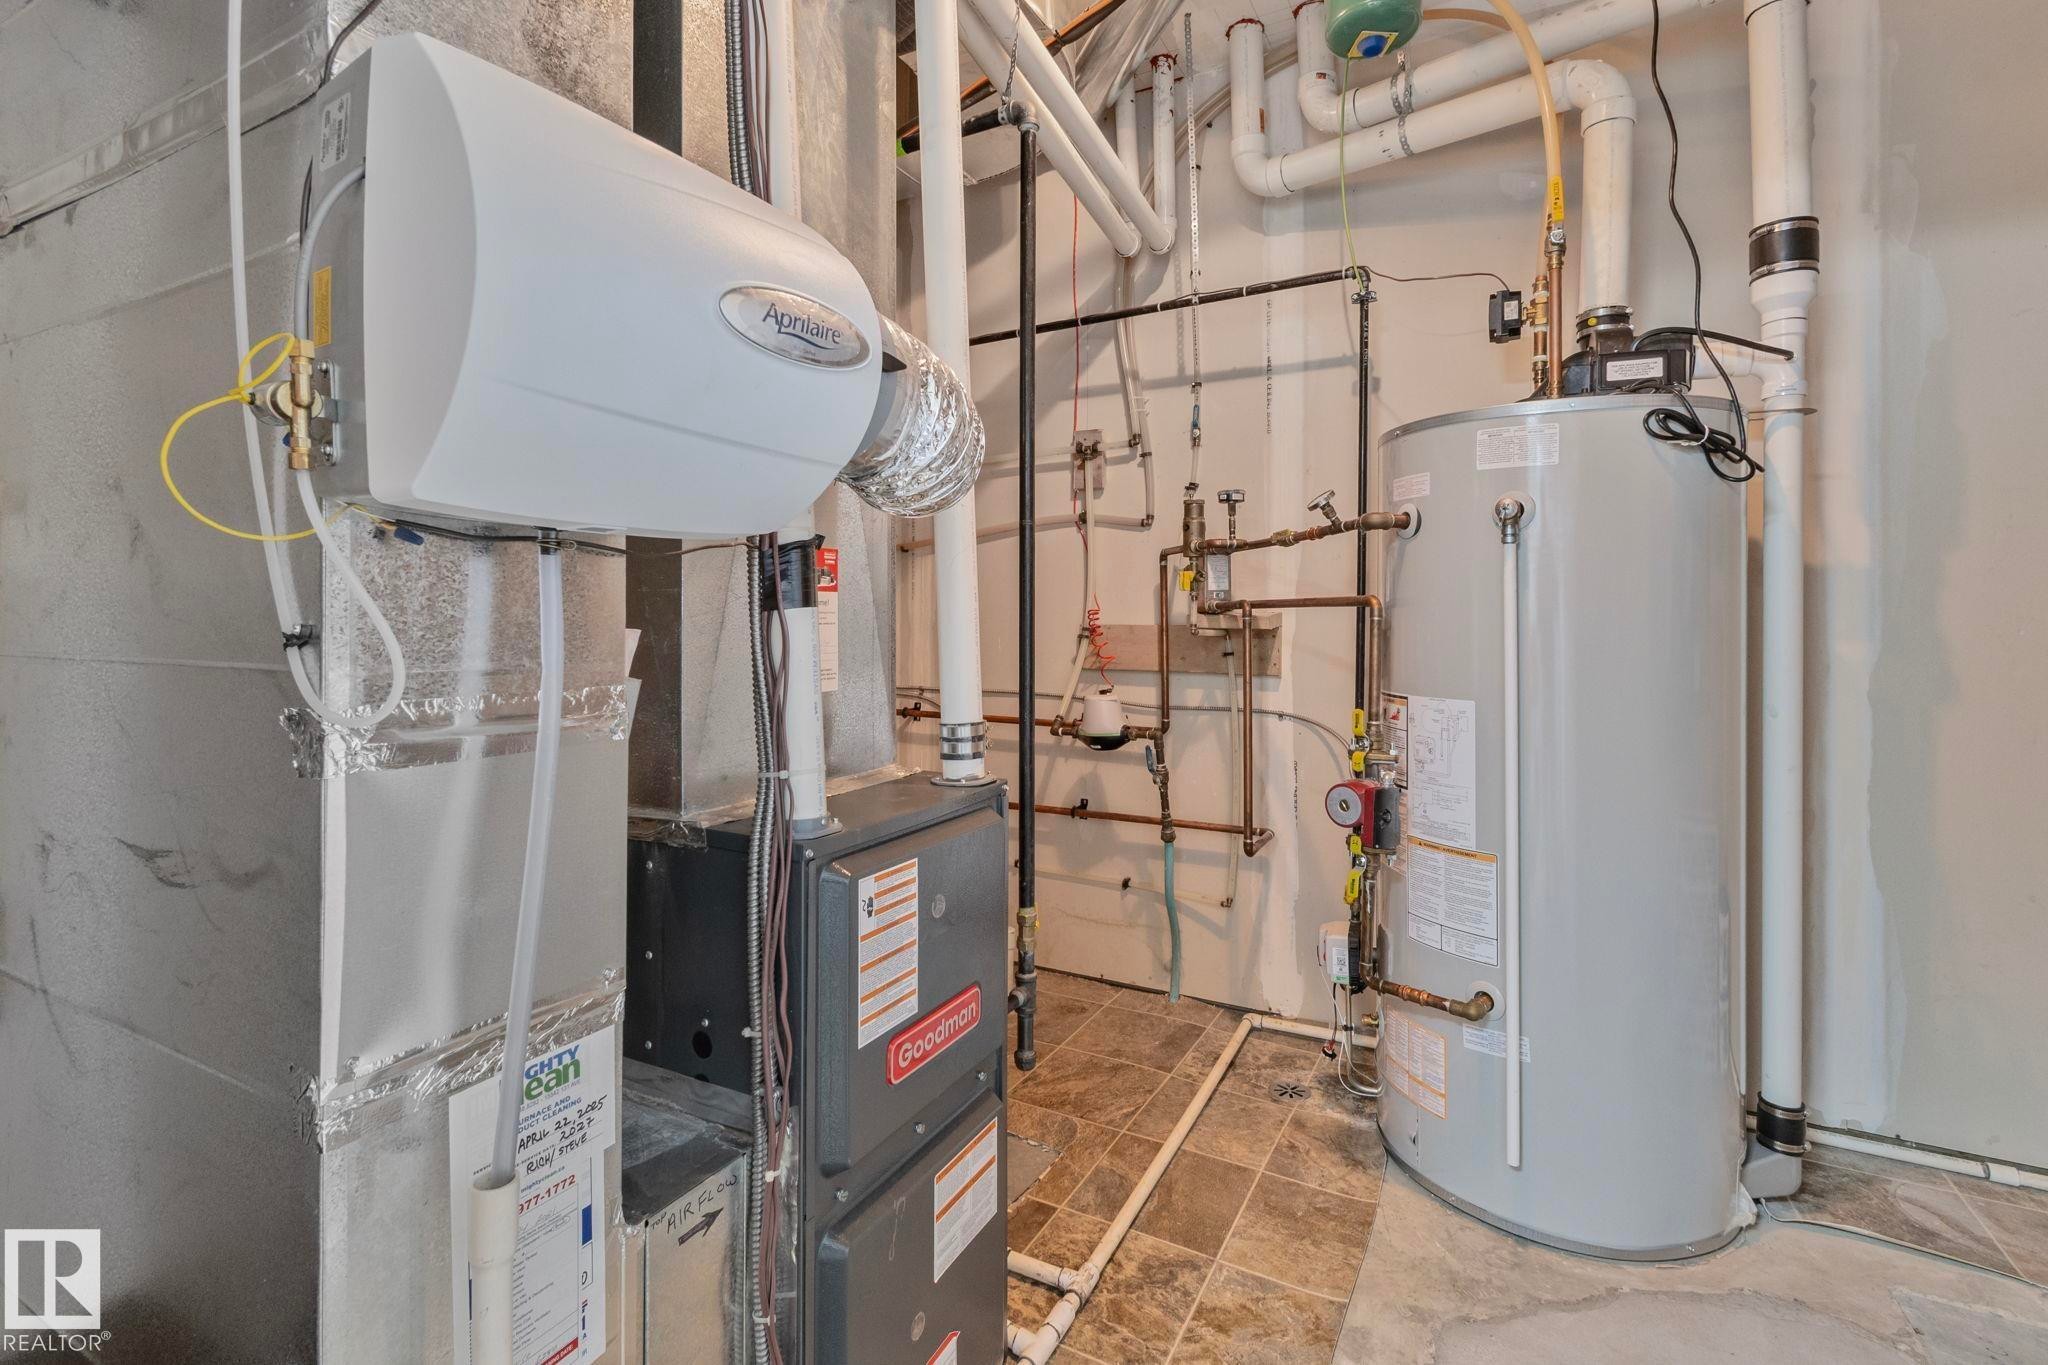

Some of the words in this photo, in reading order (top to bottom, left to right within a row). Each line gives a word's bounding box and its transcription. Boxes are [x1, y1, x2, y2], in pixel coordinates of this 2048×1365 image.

[762, 302, 841, 344] Aprilaire
[899, 1002, 976, 1068] Goodman
[524, 1059, 581, 1101] ean
[525, 1044, 580, 1080] GHTY
[541, 1097, 582, 1122] CLEANING
[555, 1096, 571, 1109] AND
[517, 1129, 550, 1154] APRIL
[577, 1094, 608, 1119] 2025
[560, 1116, 594, 1142] 2027
[558, 1132, 588, 1156] STEVE
